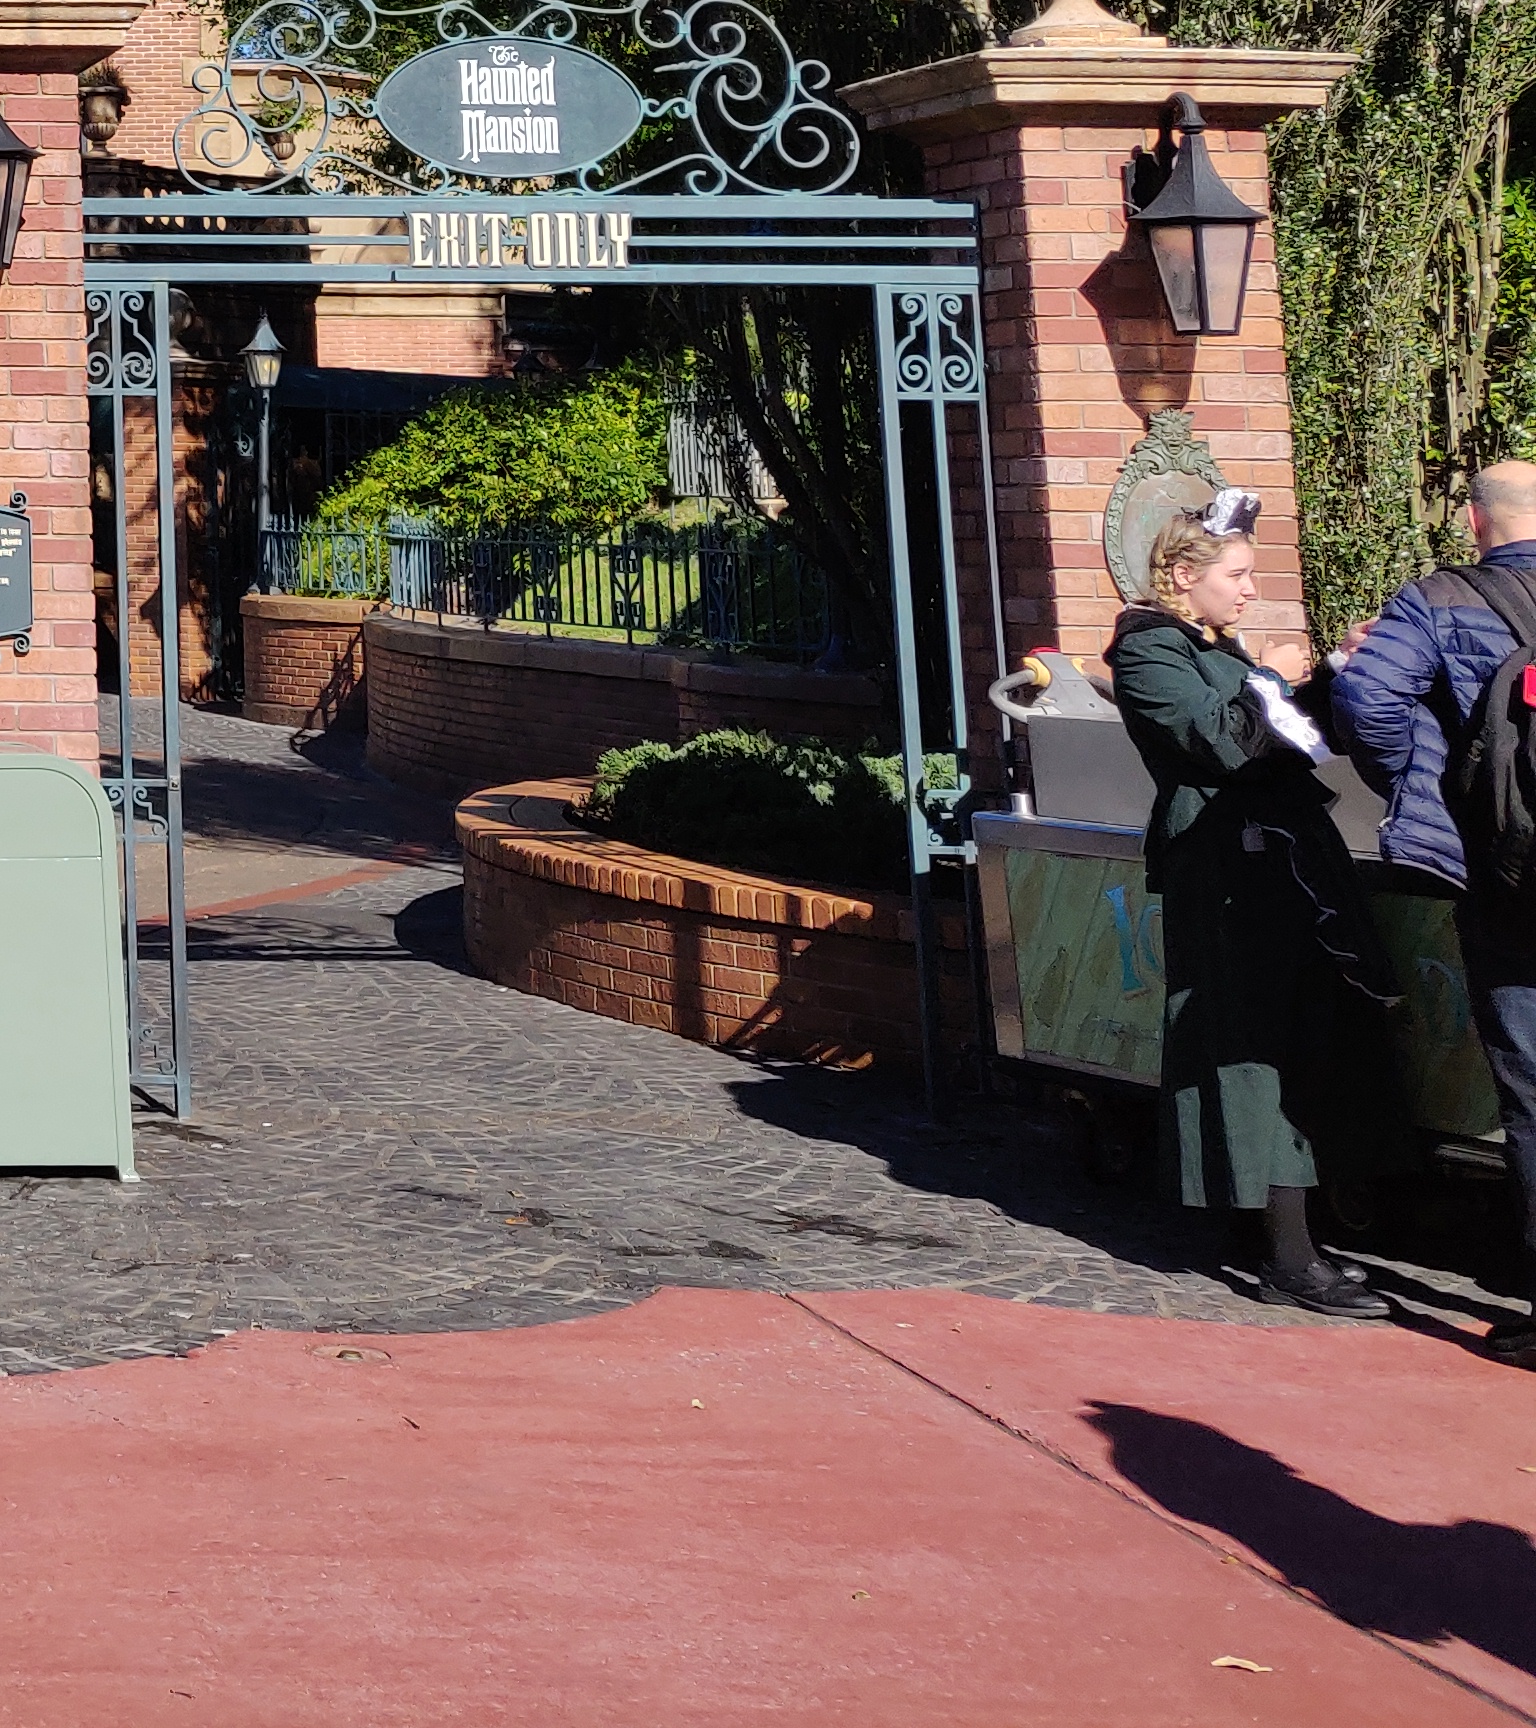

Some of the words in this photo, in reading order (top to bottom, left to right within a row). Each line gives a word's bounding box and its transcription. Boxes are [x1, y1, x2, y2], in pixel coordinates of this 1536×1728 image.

[457, 55, 556, 106] Haunted
[488, 46, 519, 65] The
[457, 107, 561, 164] Mansion
[409, 212, 509, 269] EXIT
[529, 212, 632, 269] ONLY
